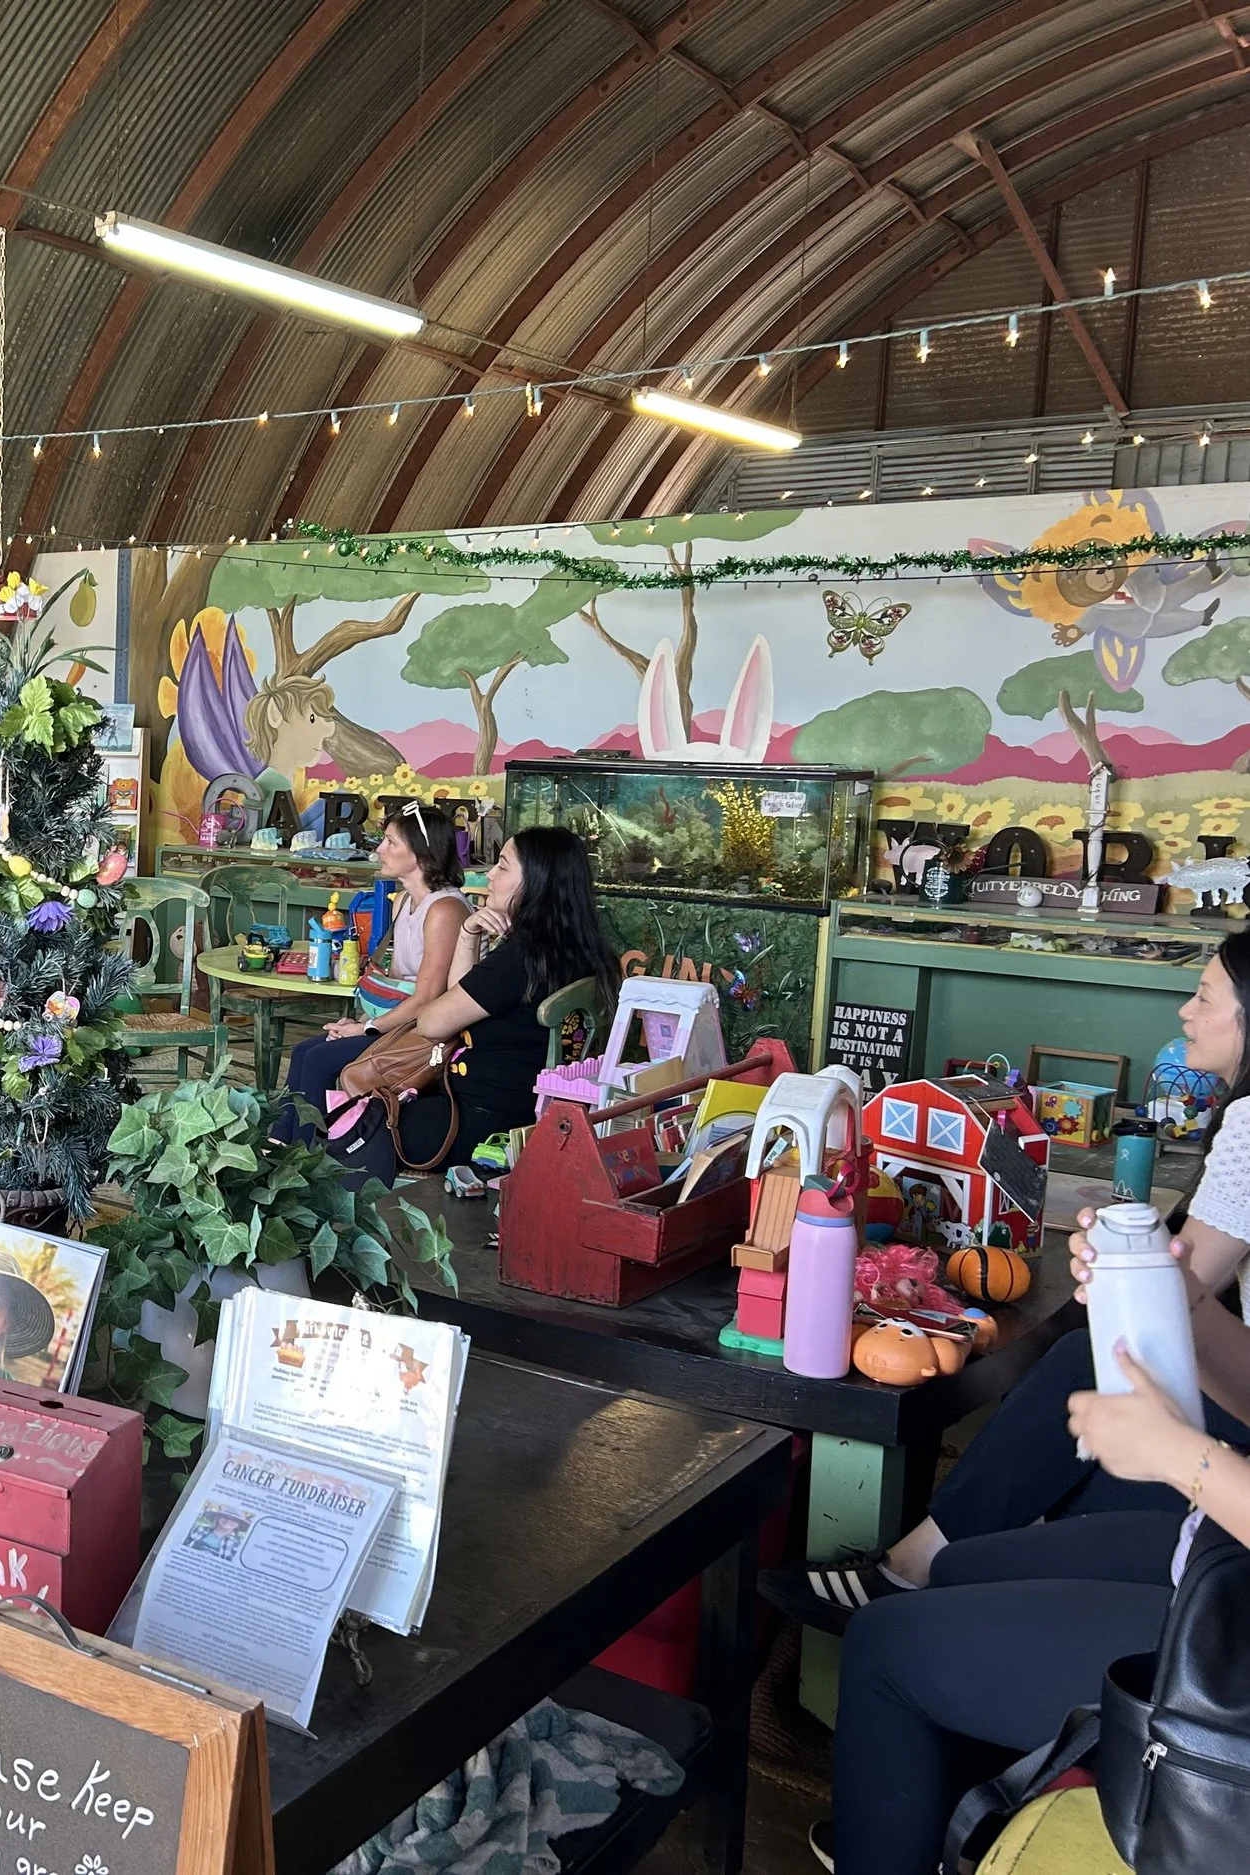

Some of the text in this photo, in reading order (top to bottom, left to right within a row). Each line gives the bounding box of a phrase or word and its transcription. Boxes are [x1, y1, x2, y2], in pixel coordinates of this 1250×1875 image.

[834, 1005, 907, 1026] HAPPINESS
[832, 1020, 904, 1043] IS NOT A
[830, 1037, 902, 1058] DESTINATION
[841, 1053, 885, 1069] IT IS A
[222, 1460, 276, 1487] CANCER
[279, 1477, 367, 1518] FUNDRAISER
